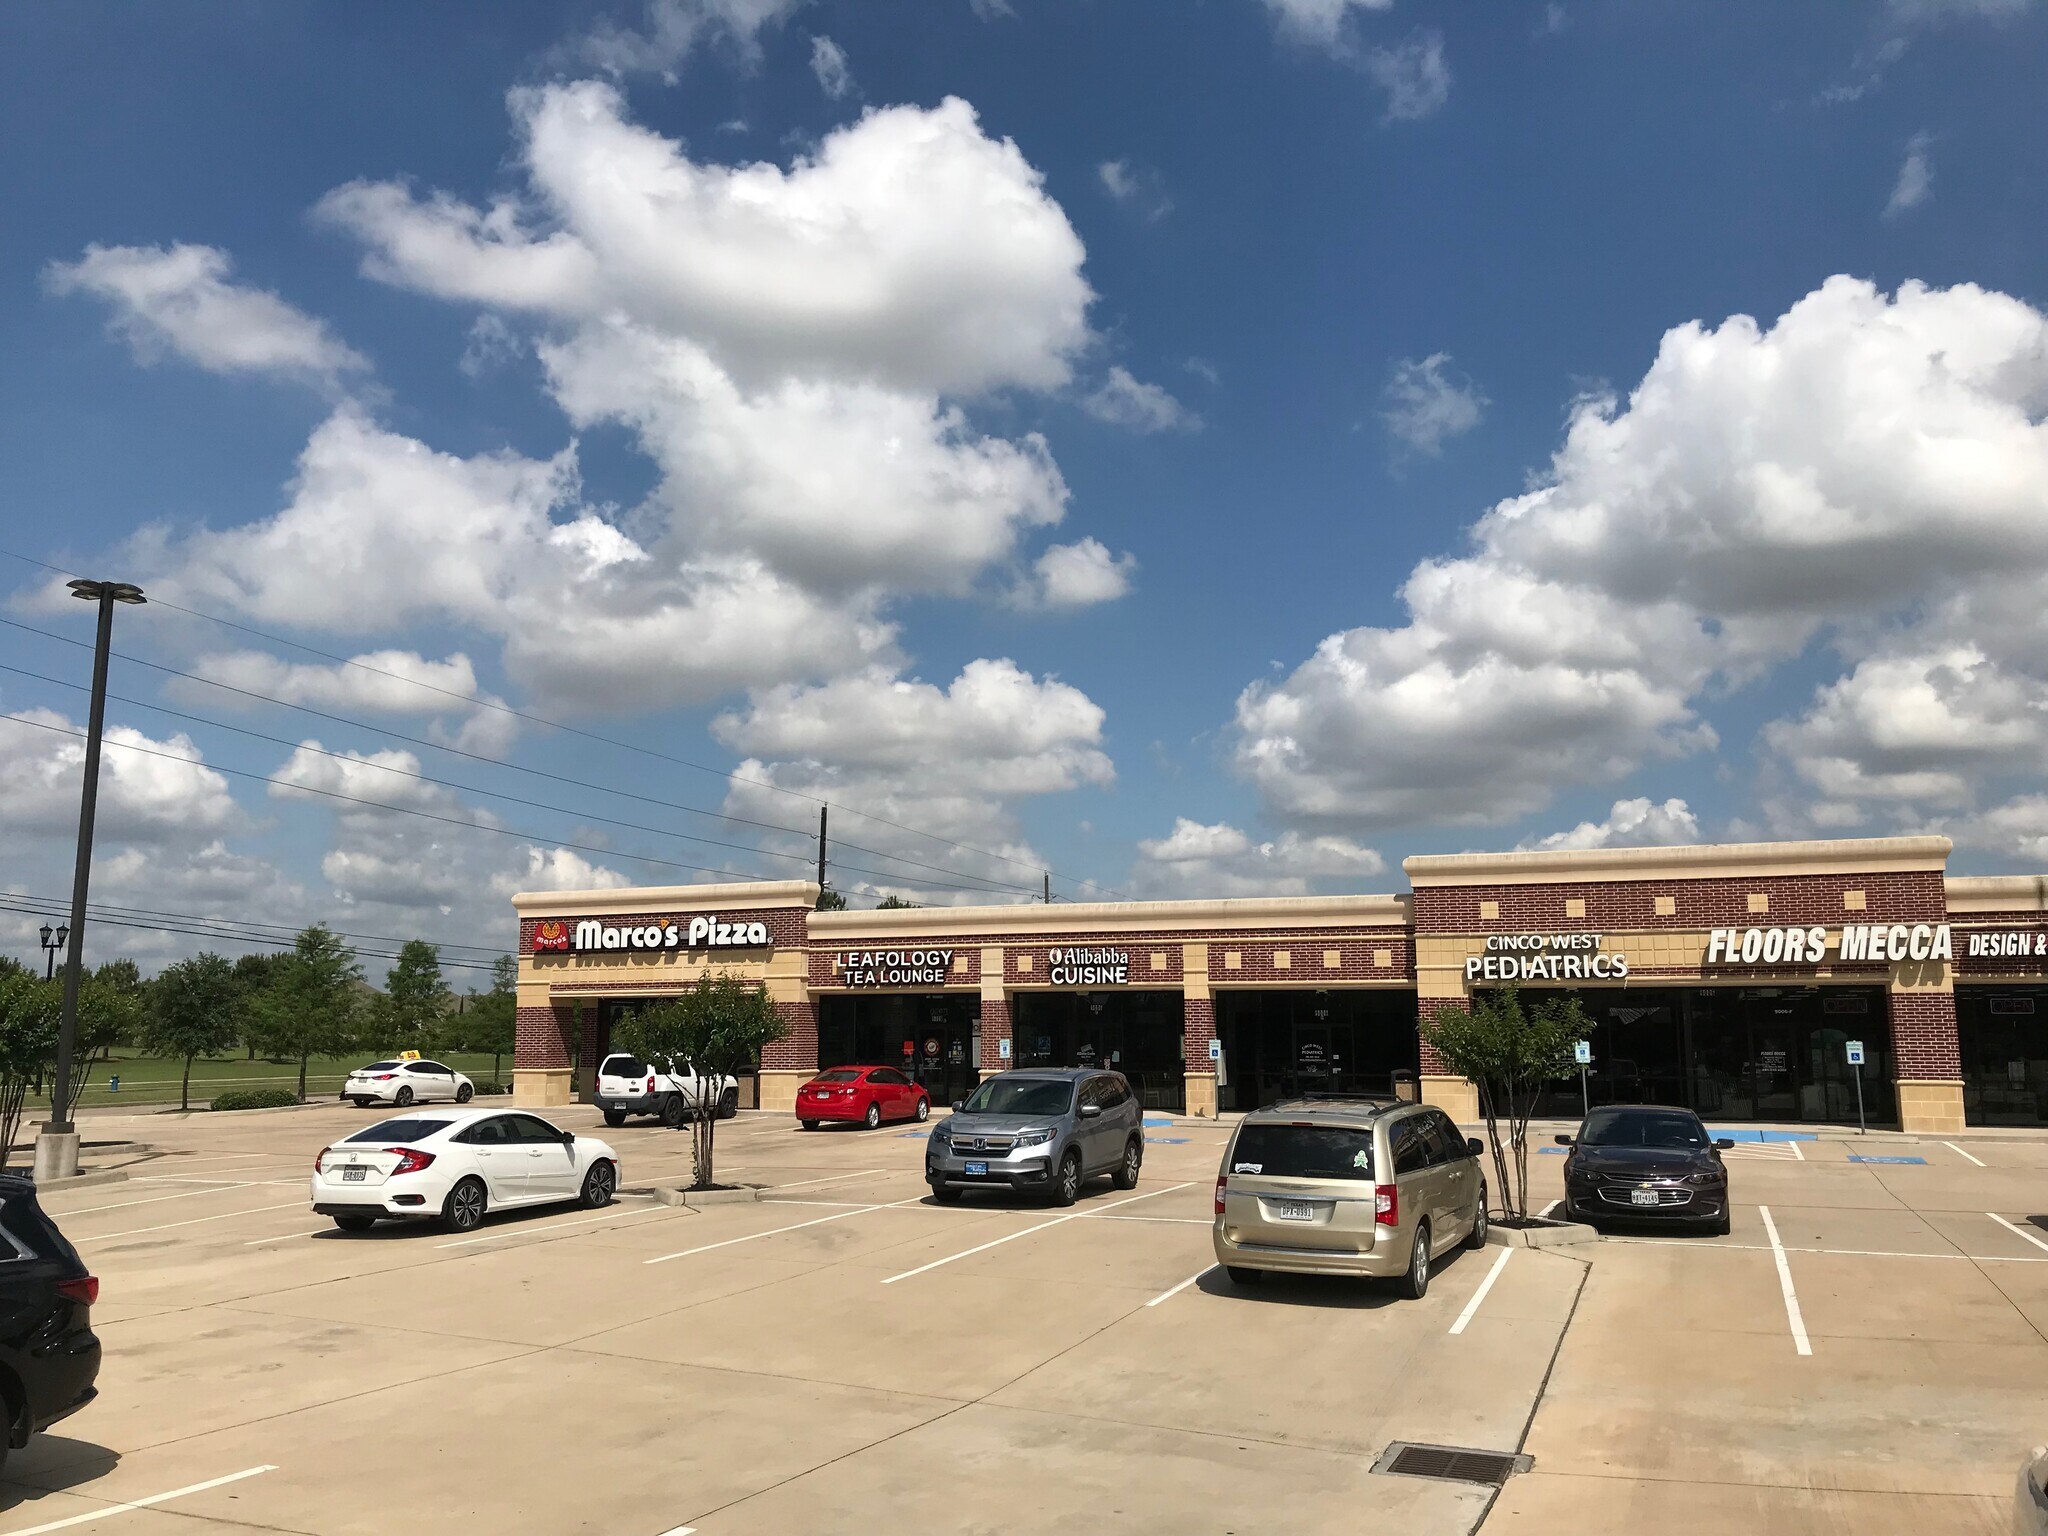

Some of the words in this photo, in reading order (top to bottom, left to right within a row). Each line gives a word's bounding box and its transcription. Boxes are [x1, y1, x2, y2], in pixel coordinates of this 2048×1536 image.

[575, 918, 679, 950] Marco's
[688, 915, 767, 946] Pizza
[1486, 935, 1544, 951] CINCO
[1549, 934, 1603, 950] WEST
[1707, 926, 1827, 964] FLOORS
[1839, 924, 1953, 961] MECCA
[1968, 932, 2031, 957] DESIGN
[2034, 933, 2048, 956] &
[836, 950, 953, 968] LEAFOLOGY
[1064, 947, 1129, 965] Alibabba
[1051, 966, 1128, 985] CUISINE
[1465, 953, 1629, 981] PEDIATRICS
[843, 971, 876, 985] TEA
[880, 969, 945, 984] LOUNGE
